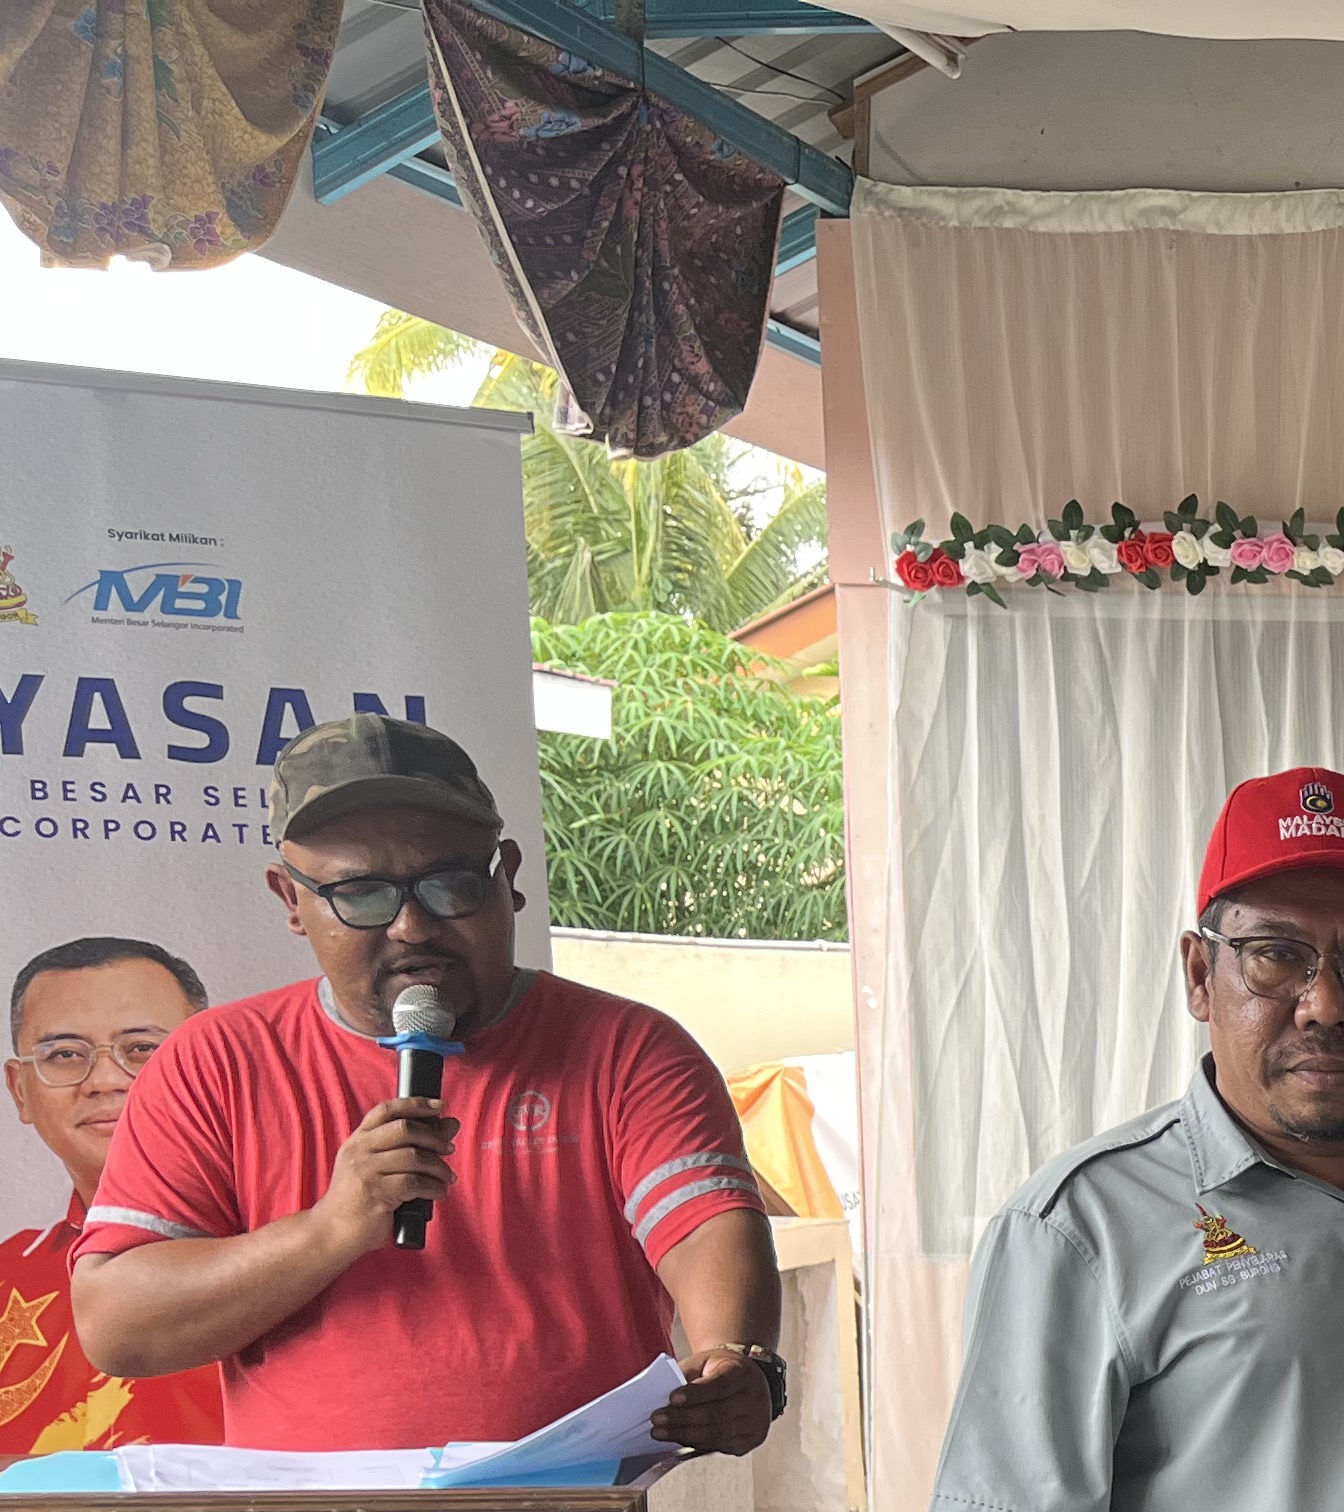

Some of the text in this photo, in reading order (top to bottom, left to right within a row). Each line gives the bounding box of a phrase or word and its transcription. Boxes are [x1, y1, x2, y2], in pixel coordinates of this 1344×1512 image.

[107, 528, 165, 542] Syarikat
[168, 533, 217, 547] Milikan
[92, 569, 242, 620] MBI
[126, 618, 149, 628] Besar
[151, 619, 188, 631] Selangor
[30, 779, 173, 805] BESAR
[1179, 1265, 1222, 1289] PEJABAT
[1195, 1281, 1217, 1296] DUN
